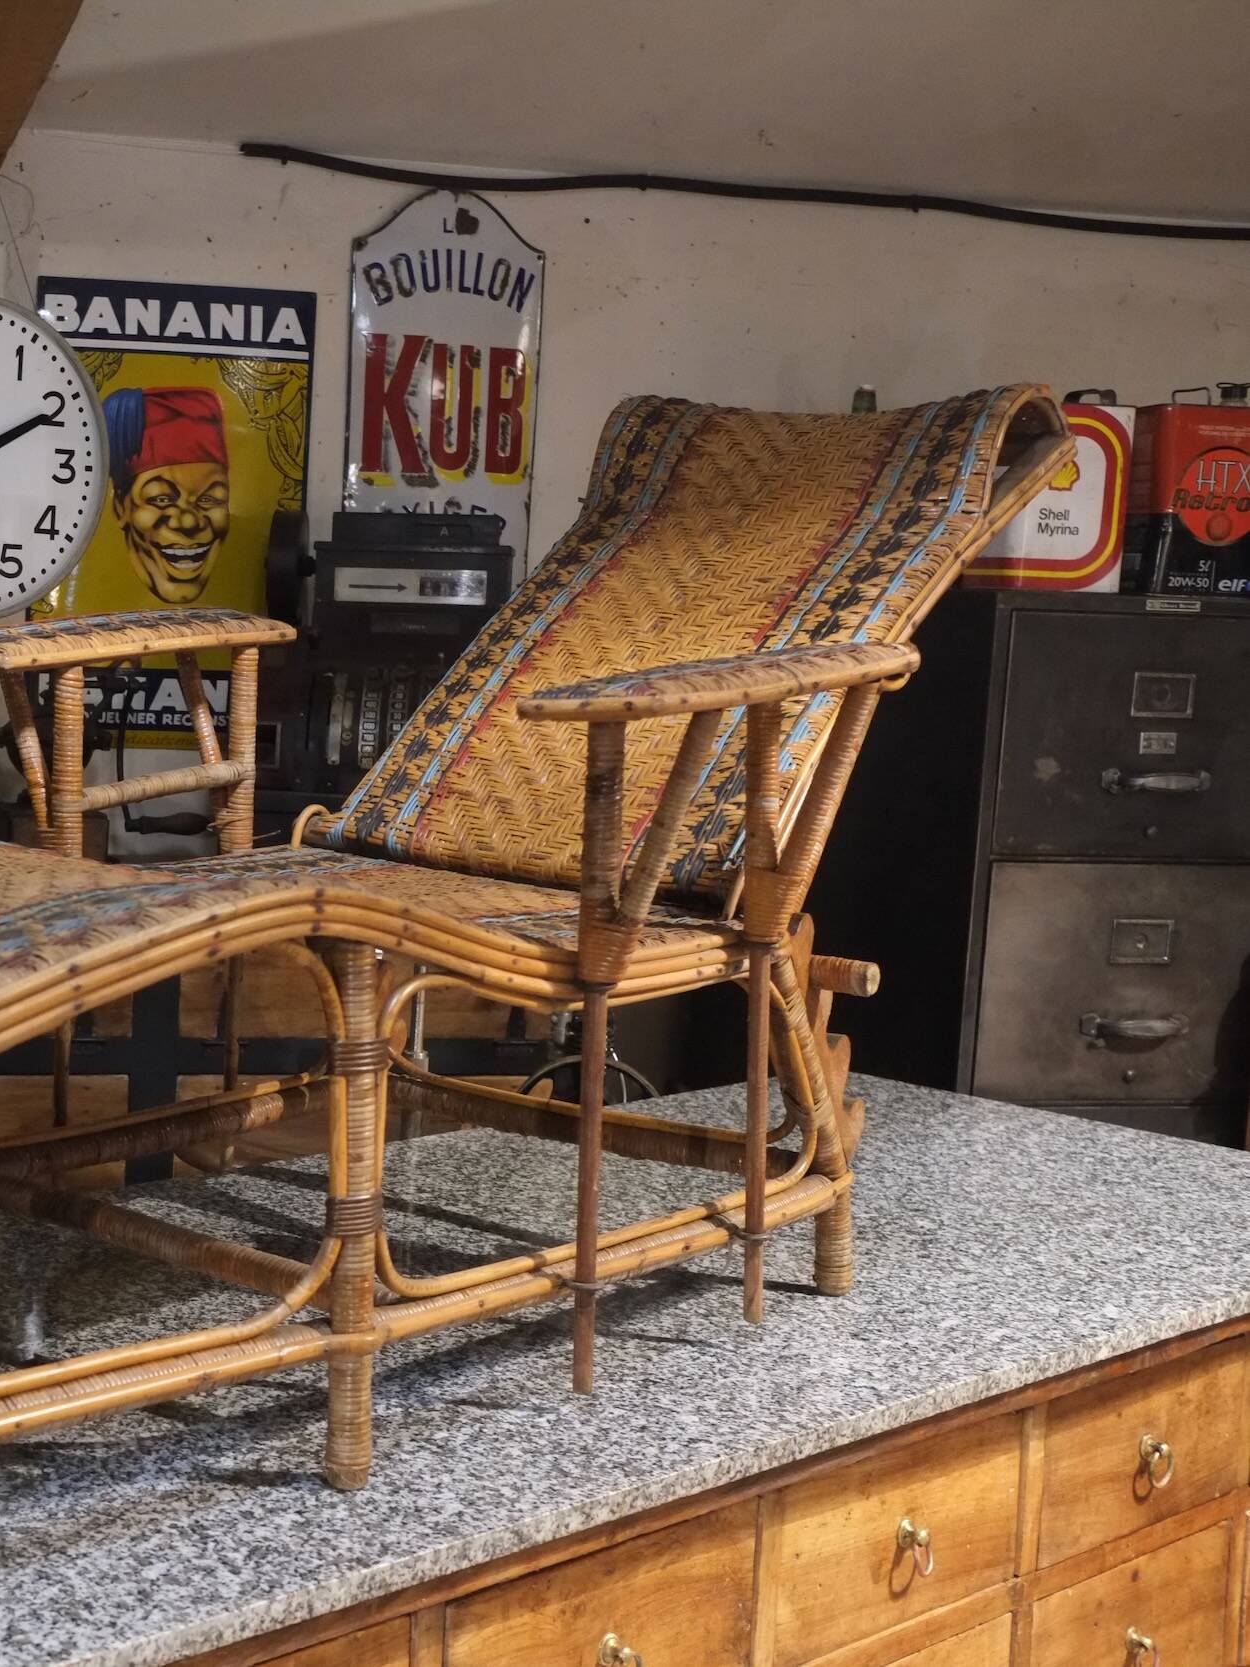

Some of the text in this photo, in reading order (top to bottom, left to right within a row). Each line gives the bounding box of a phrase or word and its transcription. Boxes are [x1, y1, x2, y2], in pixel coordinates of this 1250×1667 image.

[363, 249, 535, 313] BOUILLON
[43, 292, 307, 347] BANANIA
[15, 345, 24, 381] 1
[42, 390, 66, 427] 2
[359, 333, 530, 483] KUB
[53, 448, 76, 484] 3
[1196, 460, 1250, 494] HTX
[34, 505, 60, 541] 4
[1037, 521, 1080, 536] Myrina
[1038, 507, 1071, 521] Shell
[1168, 576, 1210, 588] 20W-50
[1217, 578, 1247, 592] elf
